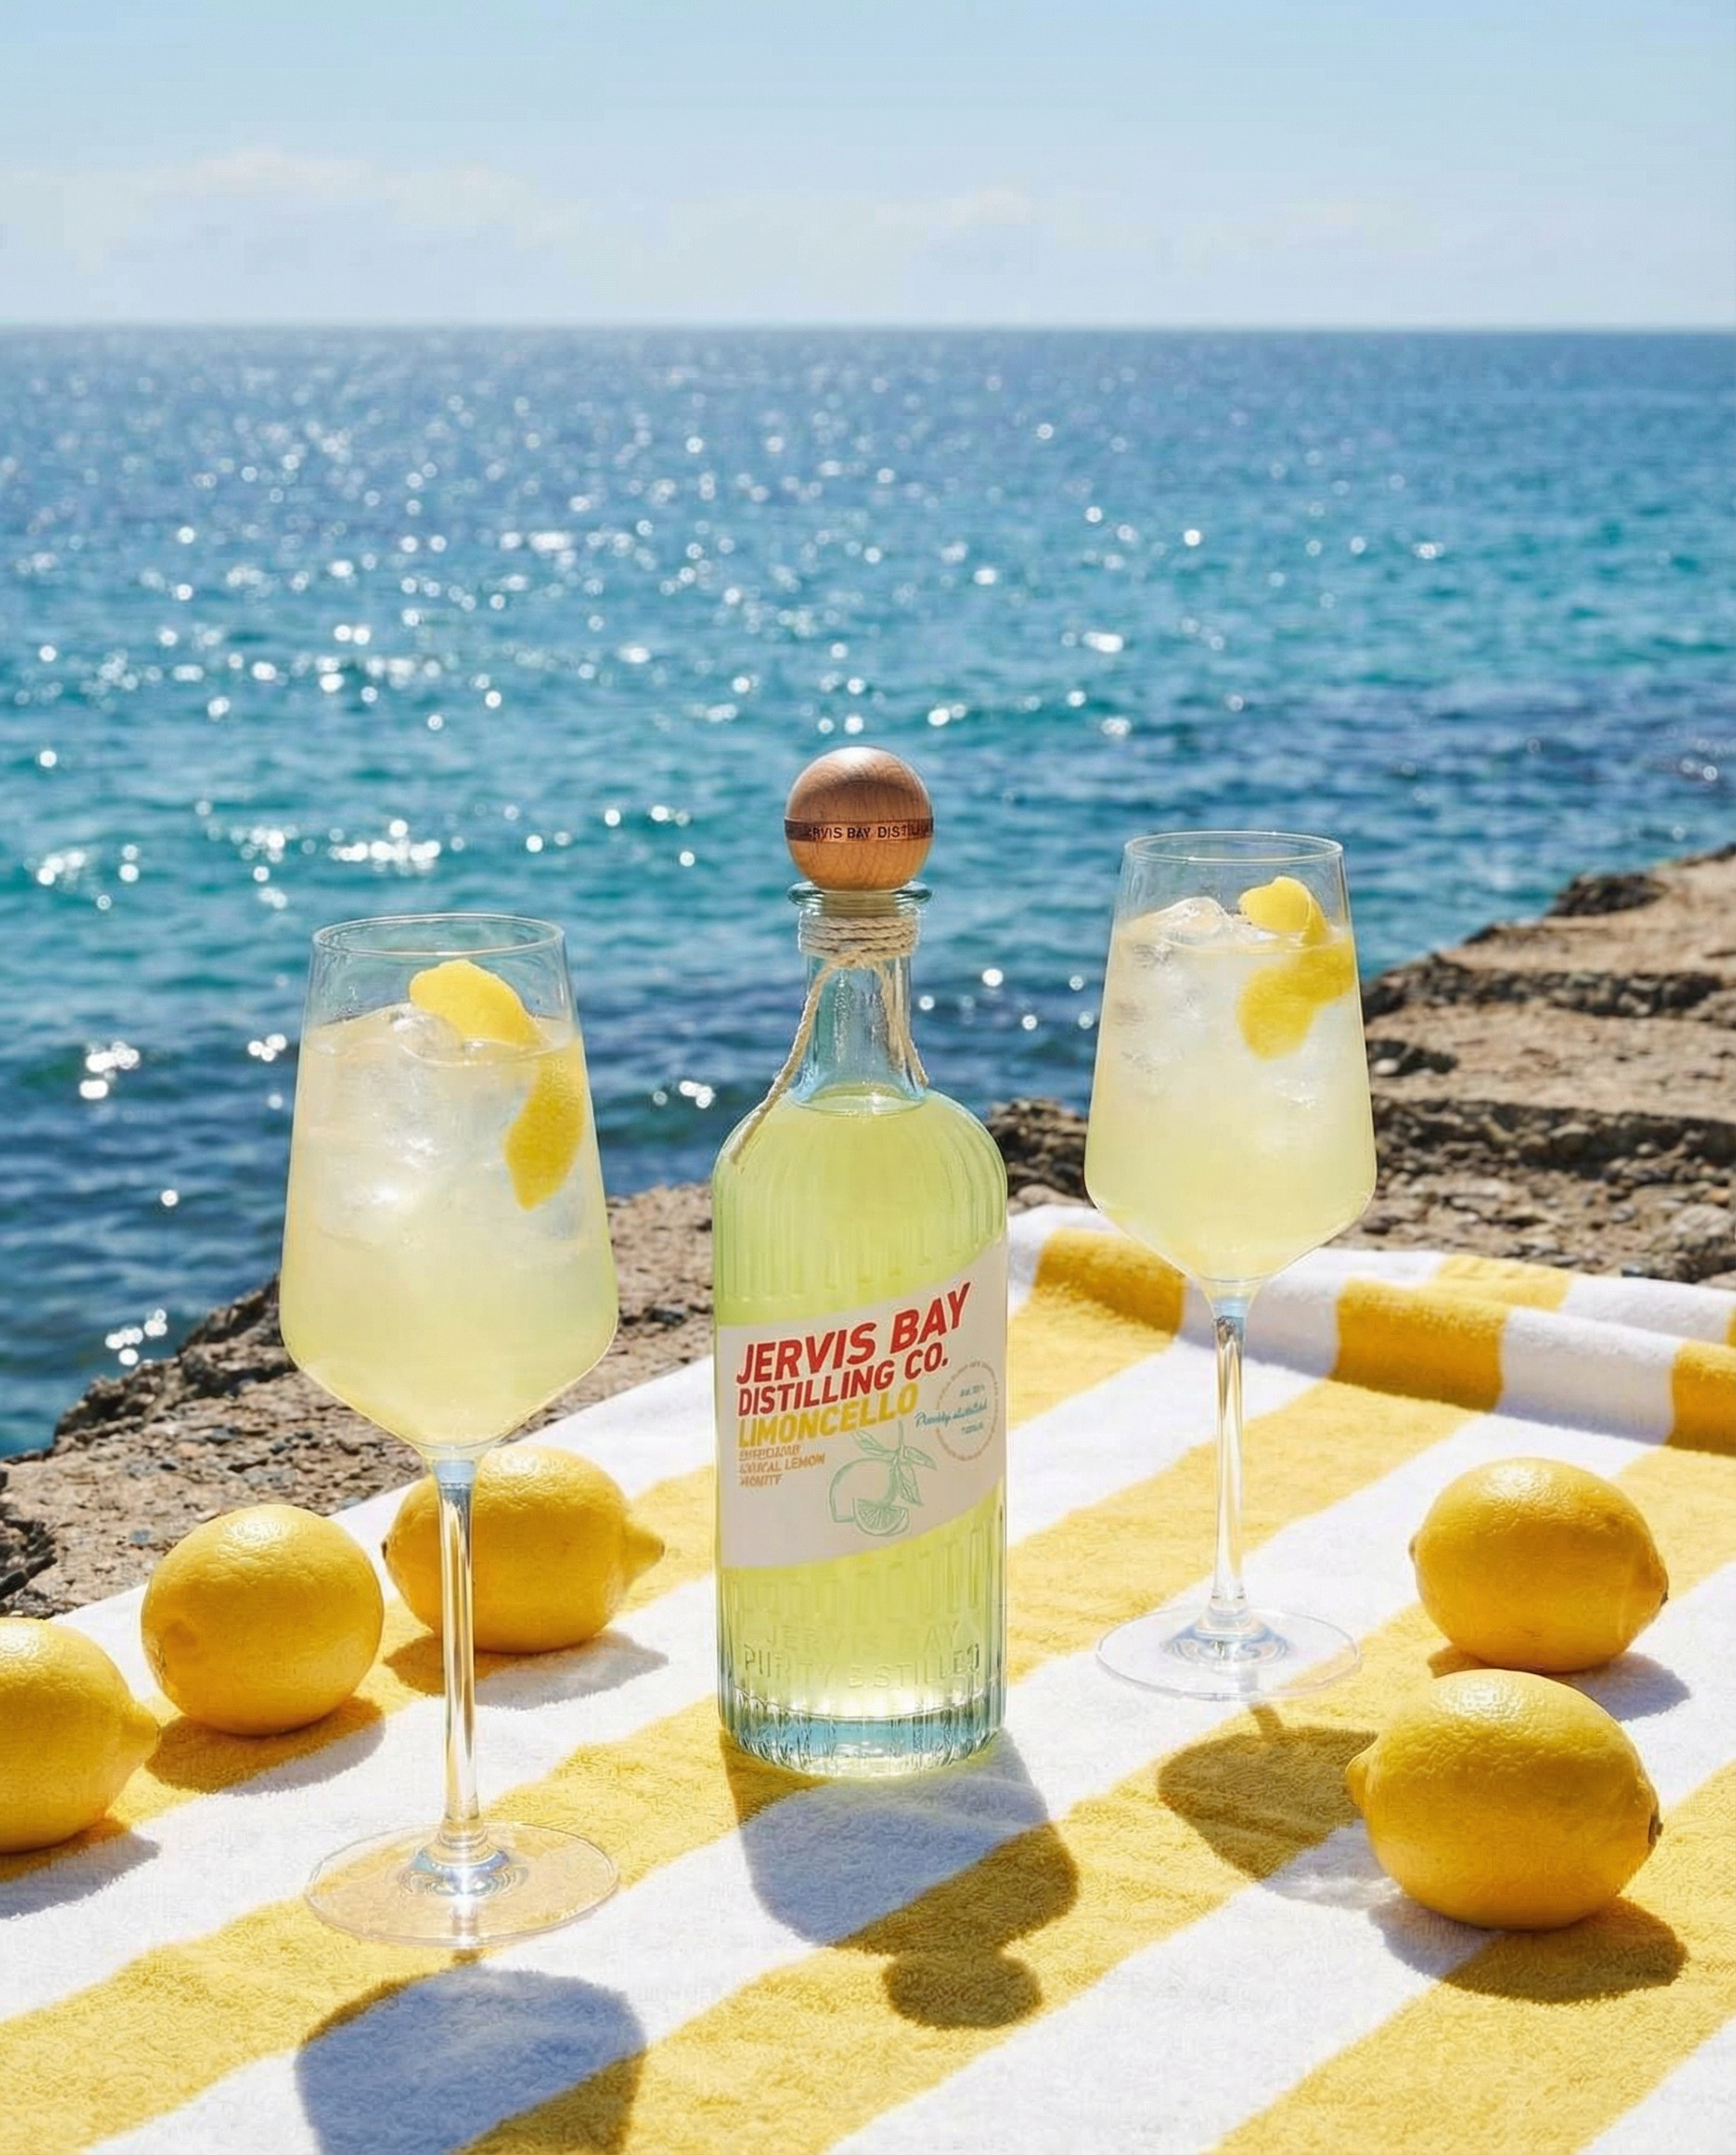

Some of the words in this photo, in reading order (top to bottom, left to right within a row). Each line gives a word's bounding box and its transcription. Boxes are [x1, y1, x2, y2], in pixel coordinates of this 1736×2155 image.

[846, 827, 871, 839] BAY
[737, 1322, 877, 1384] JERVIS
[890, 1281, 971, 1354] BAY
[738, 1359, 895, 1417] DISTILLING
[904, 1341, 948, 1381] CO.
[737, 1381, 919, 1449] LIMONCELLO
[784, 1452, 825, 1470] LEMON
